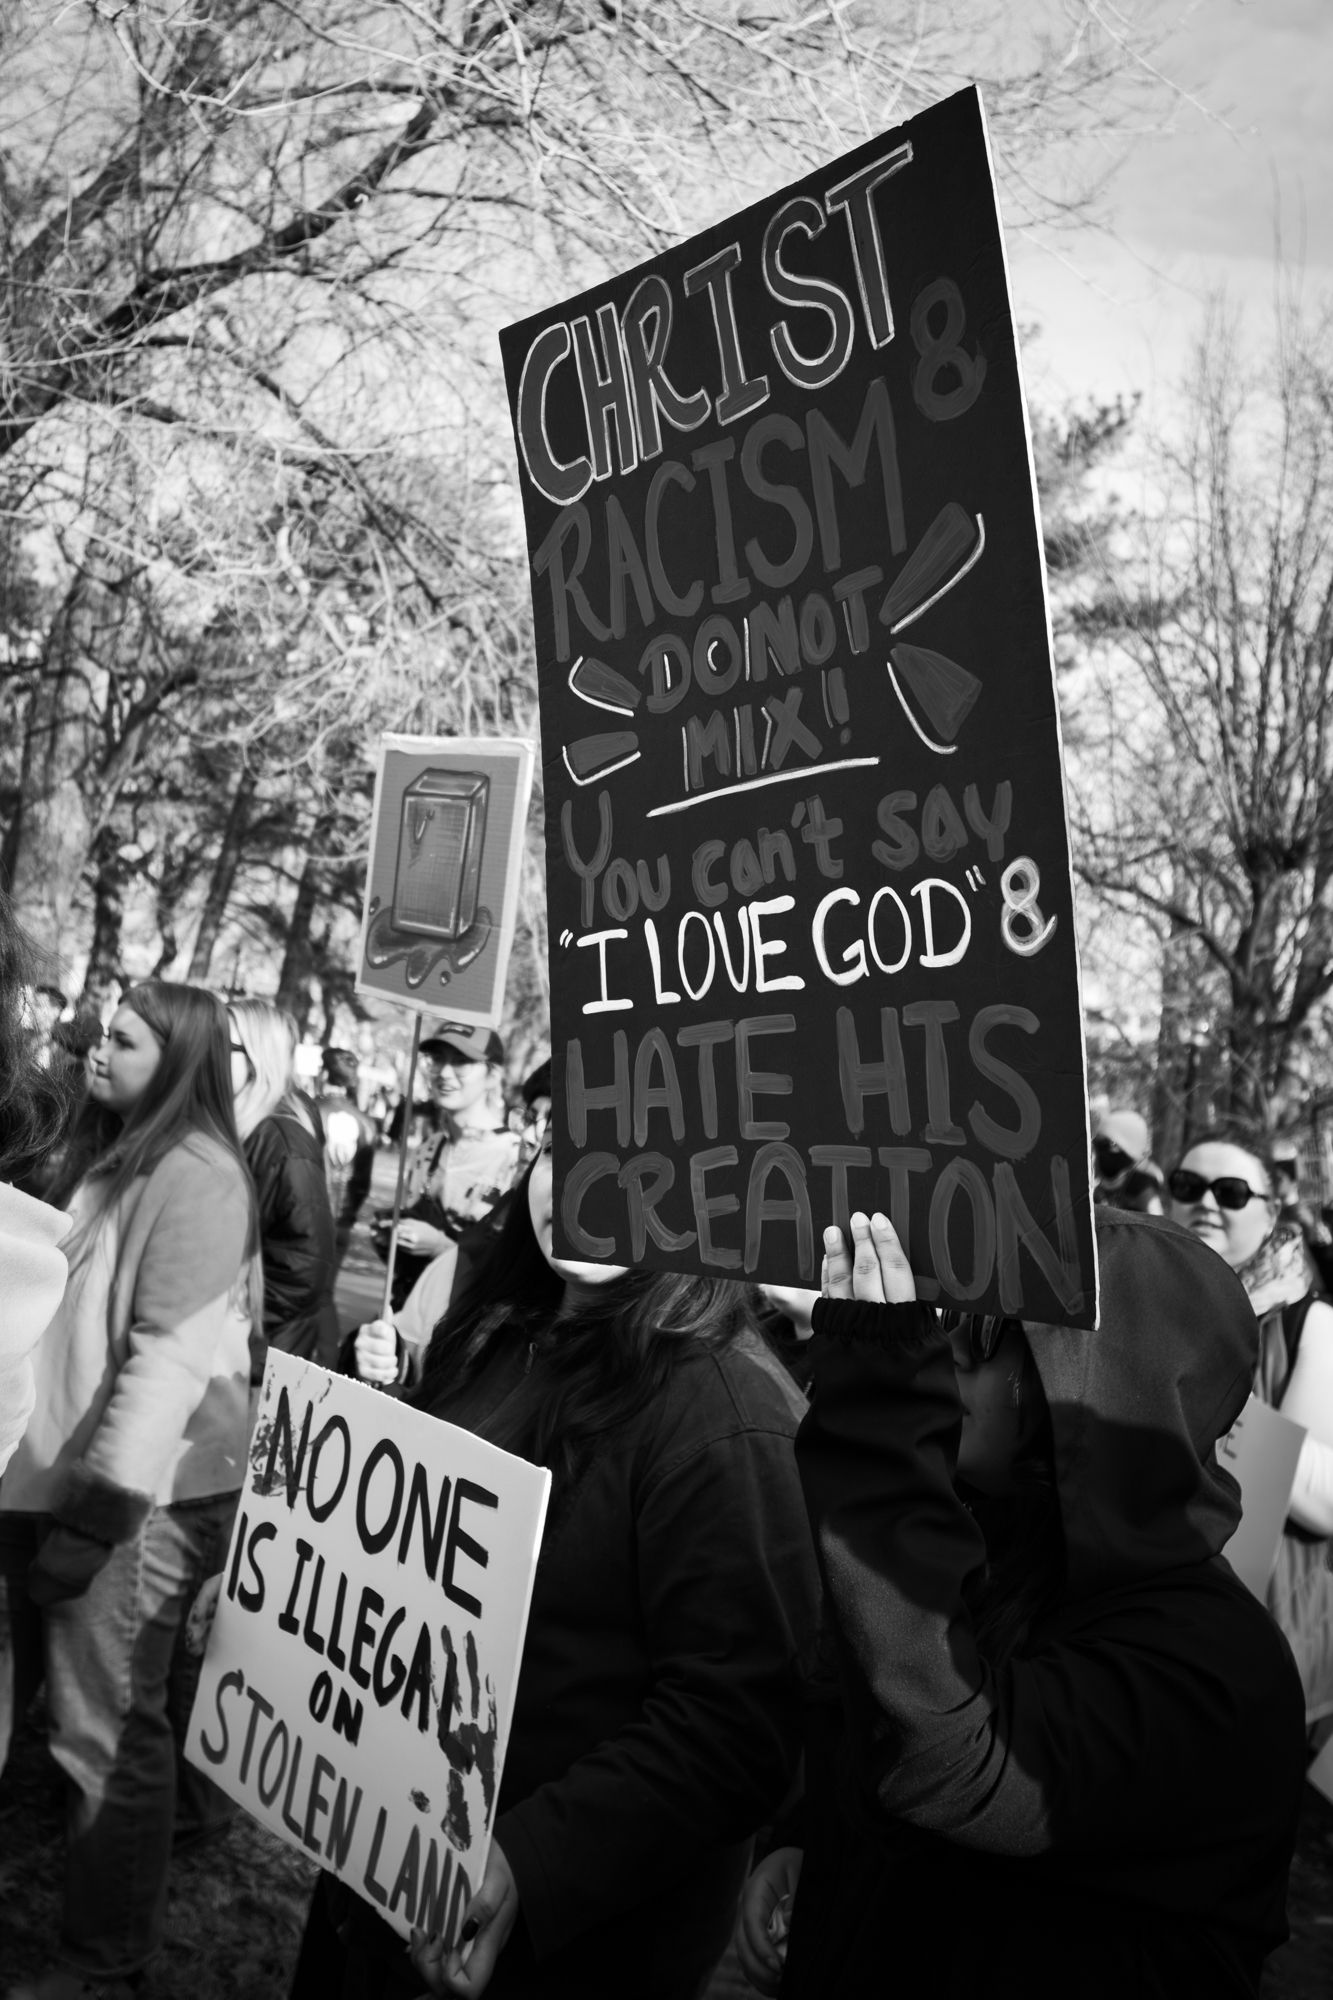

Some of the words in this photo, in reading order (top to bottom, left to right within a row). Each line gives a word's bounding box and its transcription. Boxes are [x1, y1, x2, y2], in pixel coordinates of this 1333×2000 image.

[517, 140, 914, 506] CHRIST
[532, 376, 907, 663] RACISM
[644, 894, 805, 1005] LOVE
[811, 864, 986, 986] GOD"
[1000, 855, 1058, 957] &
[692, 795, 844, 907] can't
[566, 1013, 797, 1149] HATE
[835, 1000, 1042, 1161] HIS
[561, 1142, 1087, 1315] CREATION
[262, 1385, 351, 1523] NO
[355, 1438, 500, 1620] ONE
[227, 1511, 278, 1613] IS
[278, 1537, 471, 1776] ILLEGAL
[308, 1669, 364, 1747] ON
[200, 1668, 364, 1870] STOLEN
[363, 1806, 472, 1948] LAND
